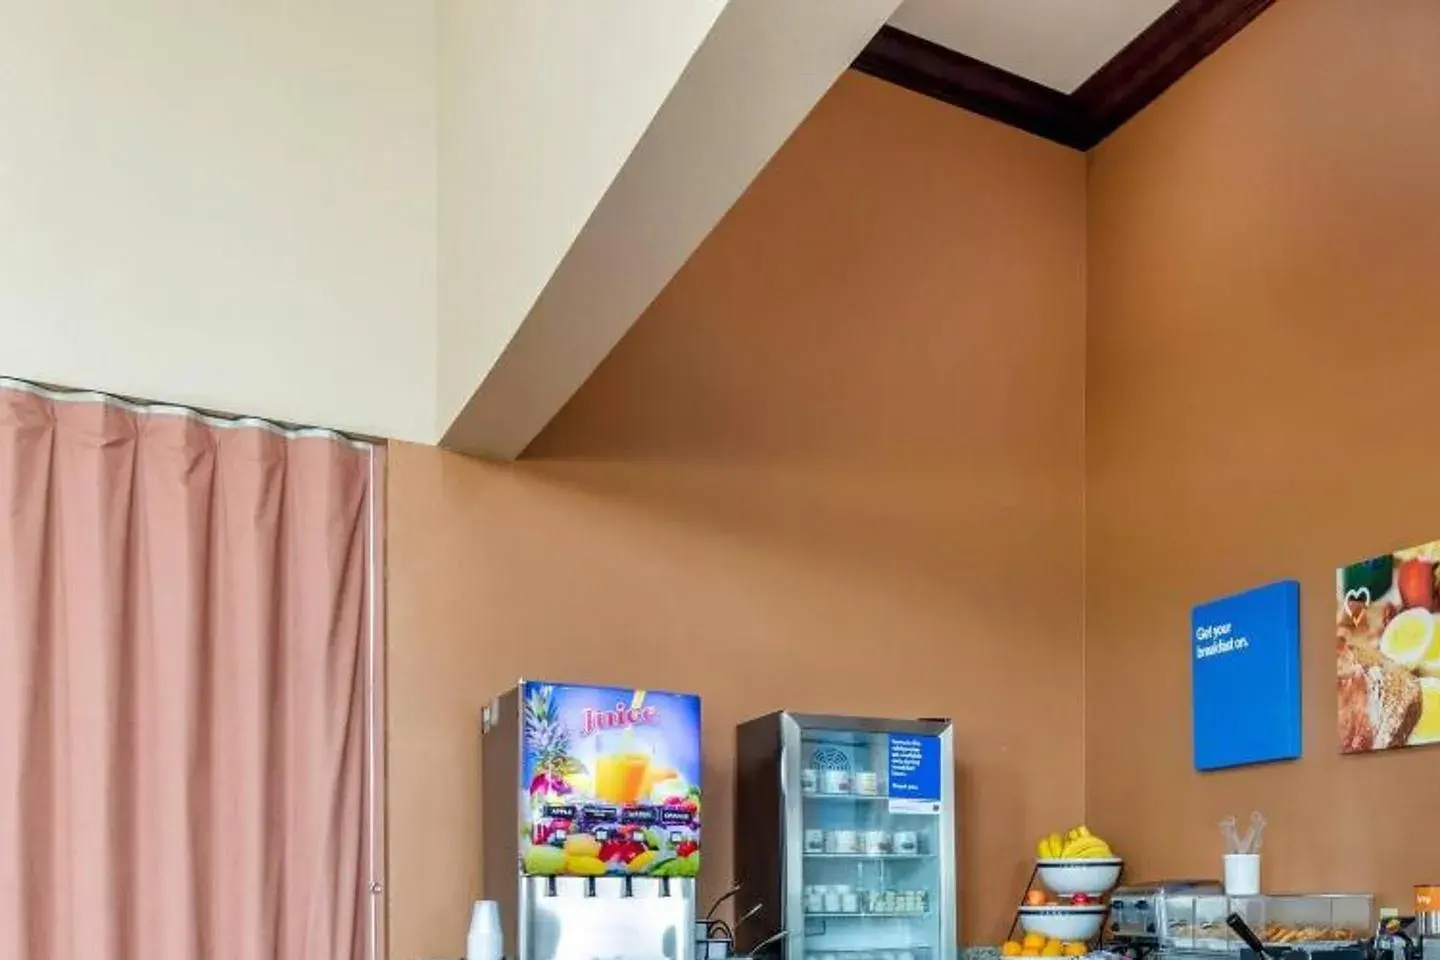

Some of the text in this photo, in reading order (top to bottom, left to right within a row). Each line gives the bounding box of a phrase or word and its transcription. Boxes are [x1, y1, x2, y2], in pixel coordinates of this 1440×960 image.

[1196, 622, 1231, 640] Get your
[1197, 637, 1233, 659] breakfast
